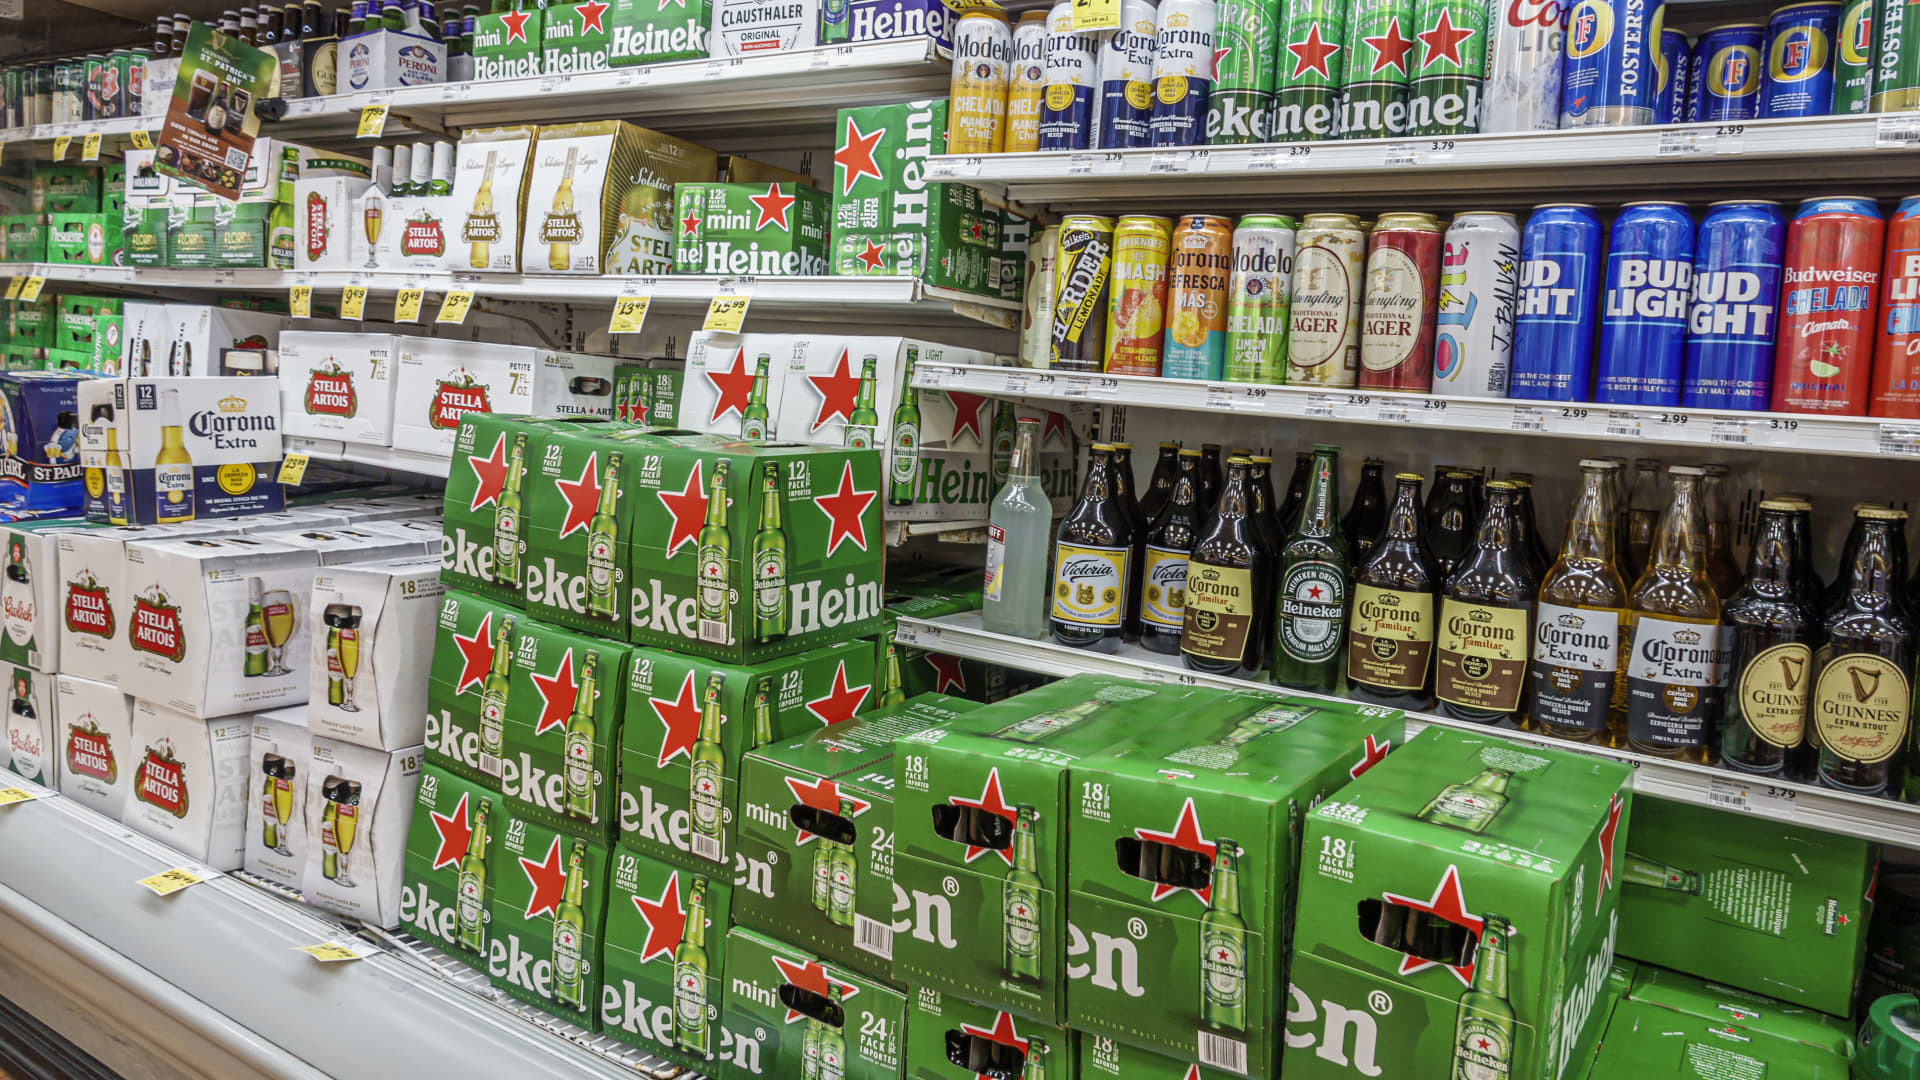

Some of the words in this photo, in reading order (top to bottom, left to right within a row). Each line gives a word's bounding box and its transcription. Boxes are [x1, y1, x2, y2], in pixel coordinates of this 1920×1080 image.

[721, 4, 803, 27] CLAUSTHALER
[545, 20, 574, 39] mini
[741, 29, 781, 41] ORIGINAL
[1575, 14, 1595, 44] F
[474, 29, 501, 48] mini
[957, 33, 1012, 62] Modelo
[1159, 47, 1193, 60] Extra
[1620, 0, 1644, 97] FOSTER'S
[1784, 41, 1807, 69] F
[398, 57, 437, 75] PERONI
[1046, 55, 1082, 68] Extra
[215, 60, 257, 84] PATRICK'S
[225, 73, 242, 86] DAY
[1726, 59, 1747, 85] F
[955, 95, 1004, 114] CHELADA
[1716, 124, 1744, 135] 2.99
[1290, 146, 1311, 156] 3.79
[1431, 141, 1454, 151] 3.79
[1105, 152, 1122, 161] 3.79
[708, 188, 721, 201] 12
[468, 218, 495, 229] STELLA
[546, 217, 576, 229] STELLA
[706, 209, 751, 231] mini
[408, 226, 438, 238] STELLA
[467, 227, 495, 238] ARTOIS
[546, 227, 576, 238] ARTOIS
[801, 224, 823, 239] mini
[407, 238, 439, 249] ARTOIS
[1063, 231, 1092, 251] mike's
[502, 255, 512, 266] 12
[585, 255, 595, 268] 12
[1232, 247, 1292, 274] Modelo
[1113, 262, 1166, 281] SMASH
[1621, 260, 1692, 288] BUD
[1784, 266, 1878, 285] Budweiser
[1074, 270, 1107, 331] LEMONADE
[1178, 291, 1206, 309] MÁS
[1786, 286, 1869, 316] CHELADA
[1227, 316, 1284, 335] CHELADA
[1801, 319, 1849, 338] Clamato
[370, 349, 388, 358] PETITE
[509, 362, 531, 372] PETITE
[314, 380, 349, 395] STELLA
[509, 373, 518, 396] 7
[657, 375, 668, 386] 18
[1101, 378, 1118, 387] 3.79
[1790, 383, 1846, 393] ORIGINAL
[139, 386, 153, 399] 12
[440, 391, 483, 408] STELLA
[1247, 388, 1266, 398] 2.99
[312, 393, 349, 408] ARTOIS
[655, 400, 673, 412] slim
[1349, 396, 1370, 406] 2.99
[1423, 401, 1447, 410] 2.99
[556, 405, 587, 415] STELLA
[654, 409, 673, 420] cans
[1562, 408, 1588, 419] 2.99
[189, 410, 276, 437] Corona
[1661, 413, 1688, 424] 2.99
[1770, 420, 1798, 431] 3.19
[461, 424, 474, 438] 12
[215, 433, 257, 449] Extra
[458, 437, 472, 445] PACK
[544, 445, 561, 460] 12
[893, 447, 918, 458] Heineken
[543, 458, 559, 467] PACK
[642, 455, 658, 470] 12
[641, 470, 658, 479] PACK
[787, 460, 806, 481] 12
[159, 472, 191, 485] Corona
[788, 481, 806, 490] PACK
[916, 457, 988, 505] Hein
[788, 488, 811, 497] IMPORTED
[1315, 481, 1328, 521] Heineken
[208, 570, 221, 579] 12
[1062, 558, 1114, 582] Victoria
[399, 579, 416, 596] 18
[1188, 575, 1240, 598] Corona
[1287, 570, 1318, 594] HEINEKEN
[1317, 570, 1343, 598] ORIGINAL
[71, 593, 106, 612] STELLA
[442, 599, 458, 613] 12
[1197, 593, 1229, 608] Familiar
[441, 611, 456, 621] PACK
[1282, 601, 1343, 618] Heineken
[1358, 600, 1421, 622] Corona
[71, 609, 107, 628] ARTOIS
[137, 609, 175, 631] STELLA
[1373, 618, 1413, 633] Familiar
[1447, 616, 1514, 641] Corona
[1538, 621, 1610, 650] Corona
[136, 625, 176, 648] ARTOIS
[519, 635, 535, 651] 12
[1462, 636, 1504, 651] Familiar
[517, 651, 533, 660] PACK
[1547, 644, 1588, 664] Extra
[633, 658, 648, 675] 12
[1662, 662, 1703, 680] Extra
[632, 673, 648, 684] PACK
[780, 671, 798, 691] 12
[1178, 675, 1197, 685] 4.19
[778, 697, 803, 709] IMPORTED
[779, 689, 798, 702] PACK
[1766, 708, 1788, 716] EXTRA
[1822, 699, 1902, 722] GUINNESS
[1834, 718, 1862, 728] EXTRA
[1862, 721, 1888, 731] STOUT
[214, 728, 226, 739] 12
[73, 736, 107, 757] STELLA
[73, 751, 108, 772] ARTOIS
[400, 756, 416, 773] 18
[905, 756, 923, 774] 18
[145, 759, 179, 788] STELLA
[905, 770, 924, 782] PACK
[422, 774, 437, 791] 12
[904, 778, 930, 790] IMPORTED
[143, 778, 179, 804] ARTOIS
[420, 787, 434, 799] PACK
[1082, 782, 1104, 801] 18
[1768, 786, 1796, 799] 3.79
[1082, 798, 1103, 811] PACK
[745, 799, 787, 831] mini
[1081, 807, 1111, 820] IMPORTED
[509, 818, 523, 836] 12
[506, 831, 522, 844] PACK
[1321, 836, 1346, 859] 18
[618, 855, 634, 873] 12
[1319, 853, 1345, 869] PACK
[616, 870, 633, 882] PACK
[1318, 863, 1354, 880] IMPORTED
[1201, 958, 1245, 978] Heineken
[731, 976, 776, 1009] mini
[918, 994, 936, 1004] PACK
[860, 1011, 887, 1040] 24
[860, 1036, 886, 1053] PACK
[859, 1047, 898, 1065] IMPORTED
[1092, 1047, 1111, 1061] PACK
[1455, 1046, 1509, 1073] Heineken
[1092, 1056, 1119, 1070] IMPORTED
